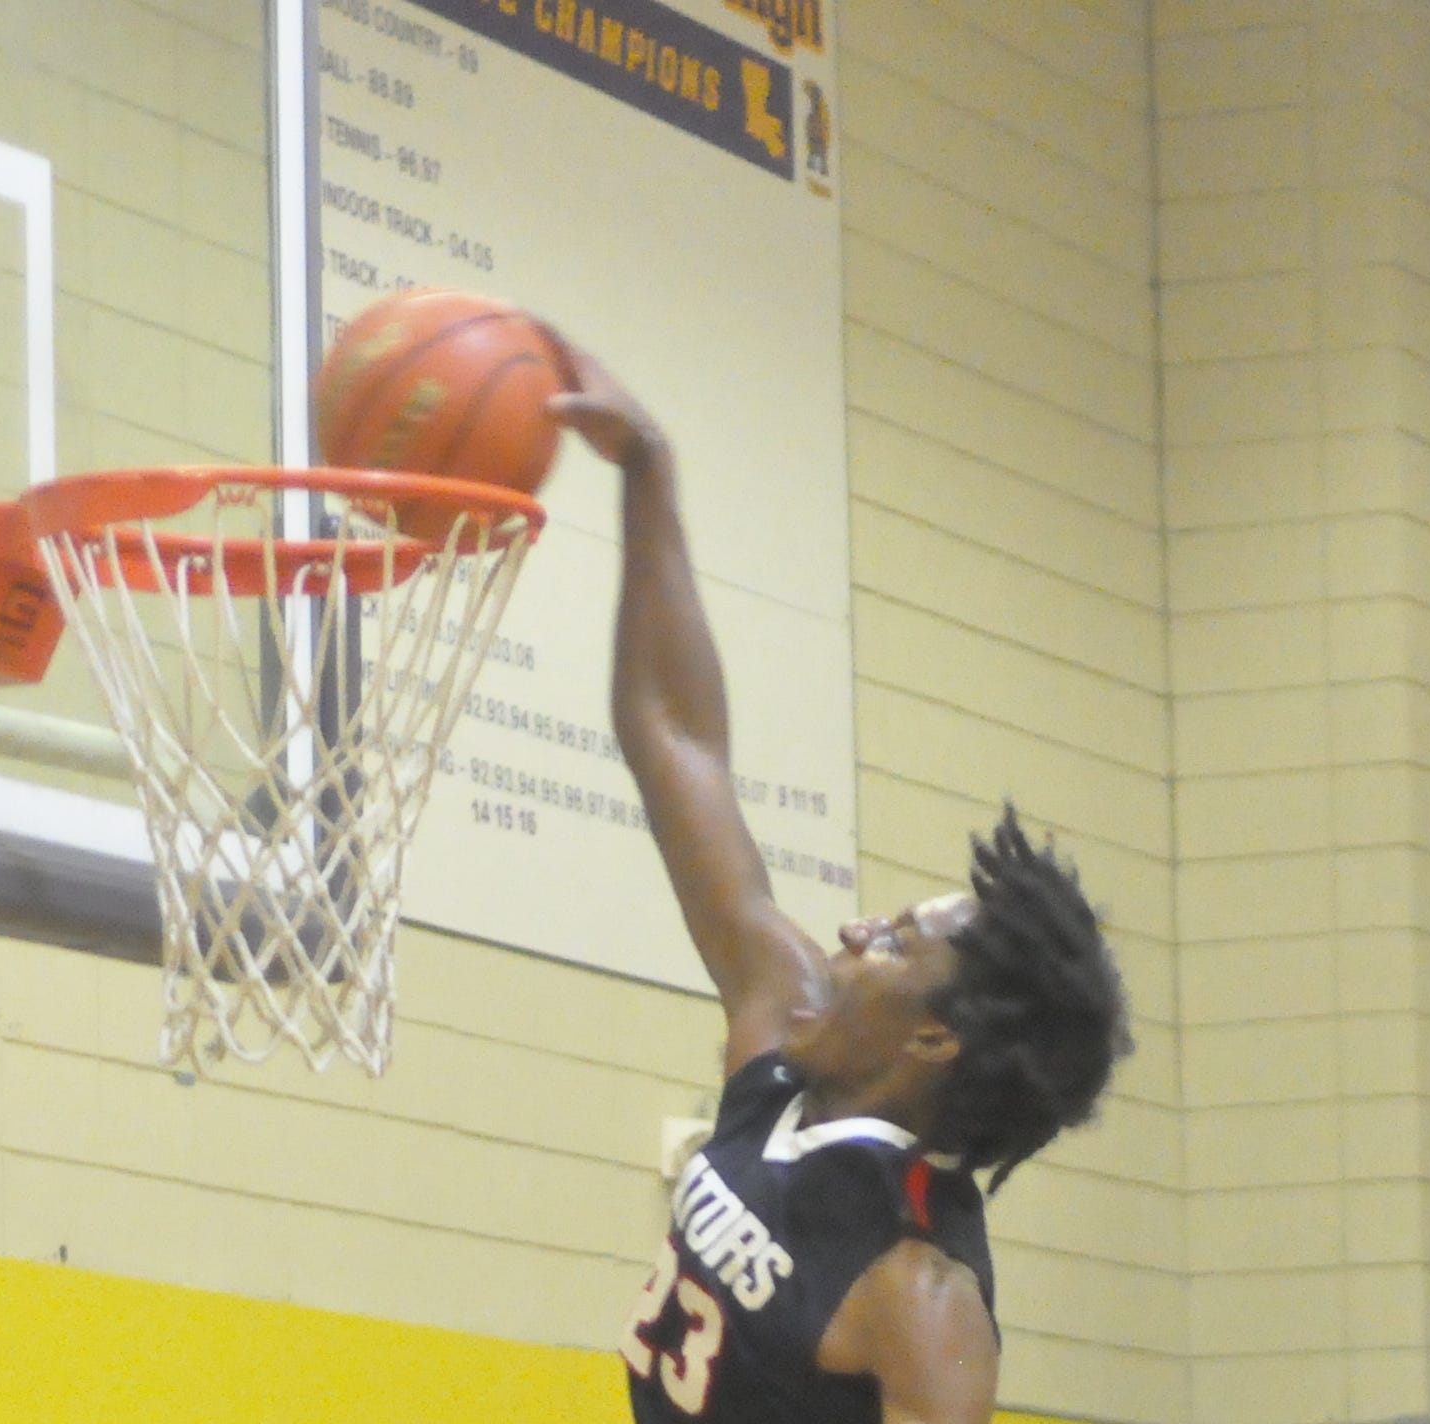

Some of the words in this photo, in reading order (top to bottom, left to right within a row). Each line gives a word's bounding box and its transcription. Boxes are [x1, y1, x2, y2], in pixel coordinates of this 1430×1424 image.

[533, 0, 721, 111] CHAMPIONS
[386, 205, 432, 246] TRACK
[329, 248, 379, 290] TRACK
